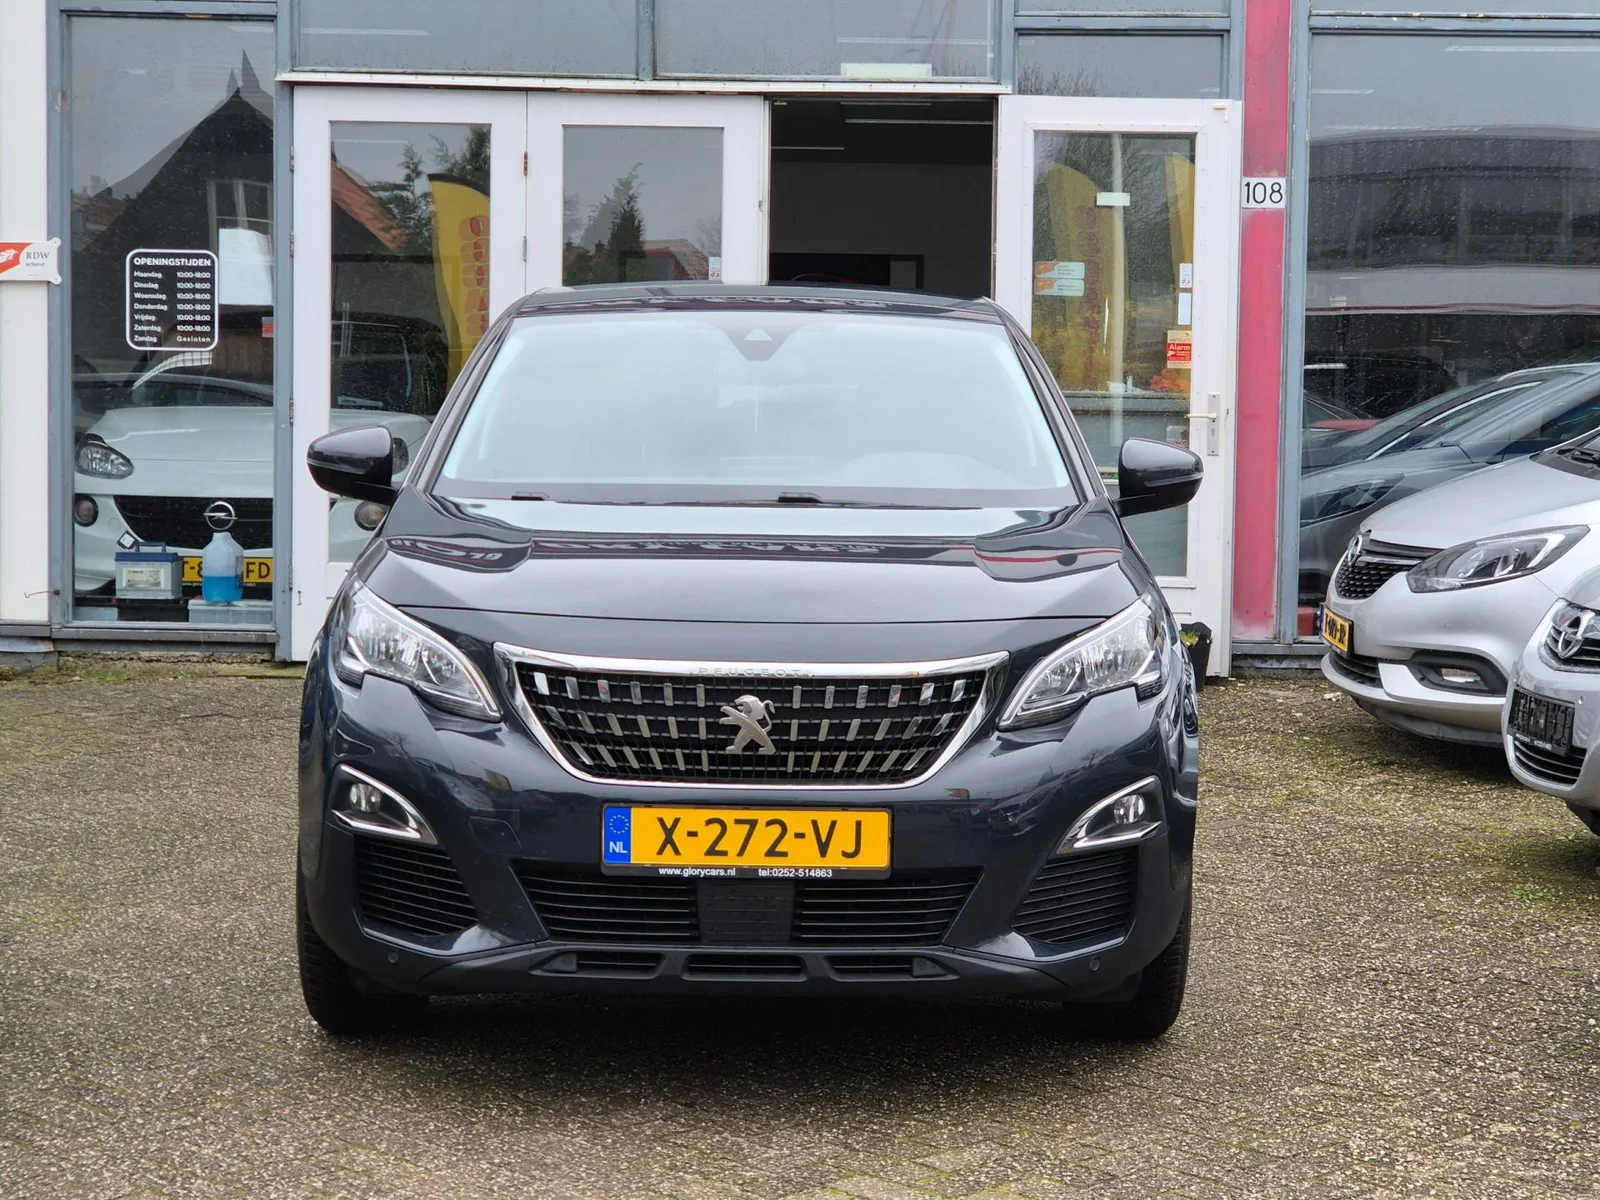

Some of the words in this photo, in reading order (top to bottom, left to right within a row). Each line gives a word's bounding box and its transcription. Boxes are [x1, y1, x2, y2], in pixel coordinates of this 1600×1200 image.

[1244, 181, 1283, 204] 108
[26, 251, 50, 260] RDW
[133, 257, 211, 266] OPENINGSTIJDEN
[133, 270, 163, 279] Maandag
[133, 281, 159, 290] Dinsdag
[133, 292, 167, 300] Woensdag
[133, 303, 168, 311] Donderdag
[133, 313, 156, 321] Vrijdag
[133, 324, 162, 332] Zaterdag
[133, 335, 158, 343] Zondag
[176, 335, 211, 343] Gesloten
[698, 667, 802, 678] PEUGEOT
[656, 817, 863, 859] X-272-VJ
[609, 841, 629, 853] NL
[658, 866, 736, 877] www.glorycars.nl
[758, 868, 833, 878] tel:0252-514863
